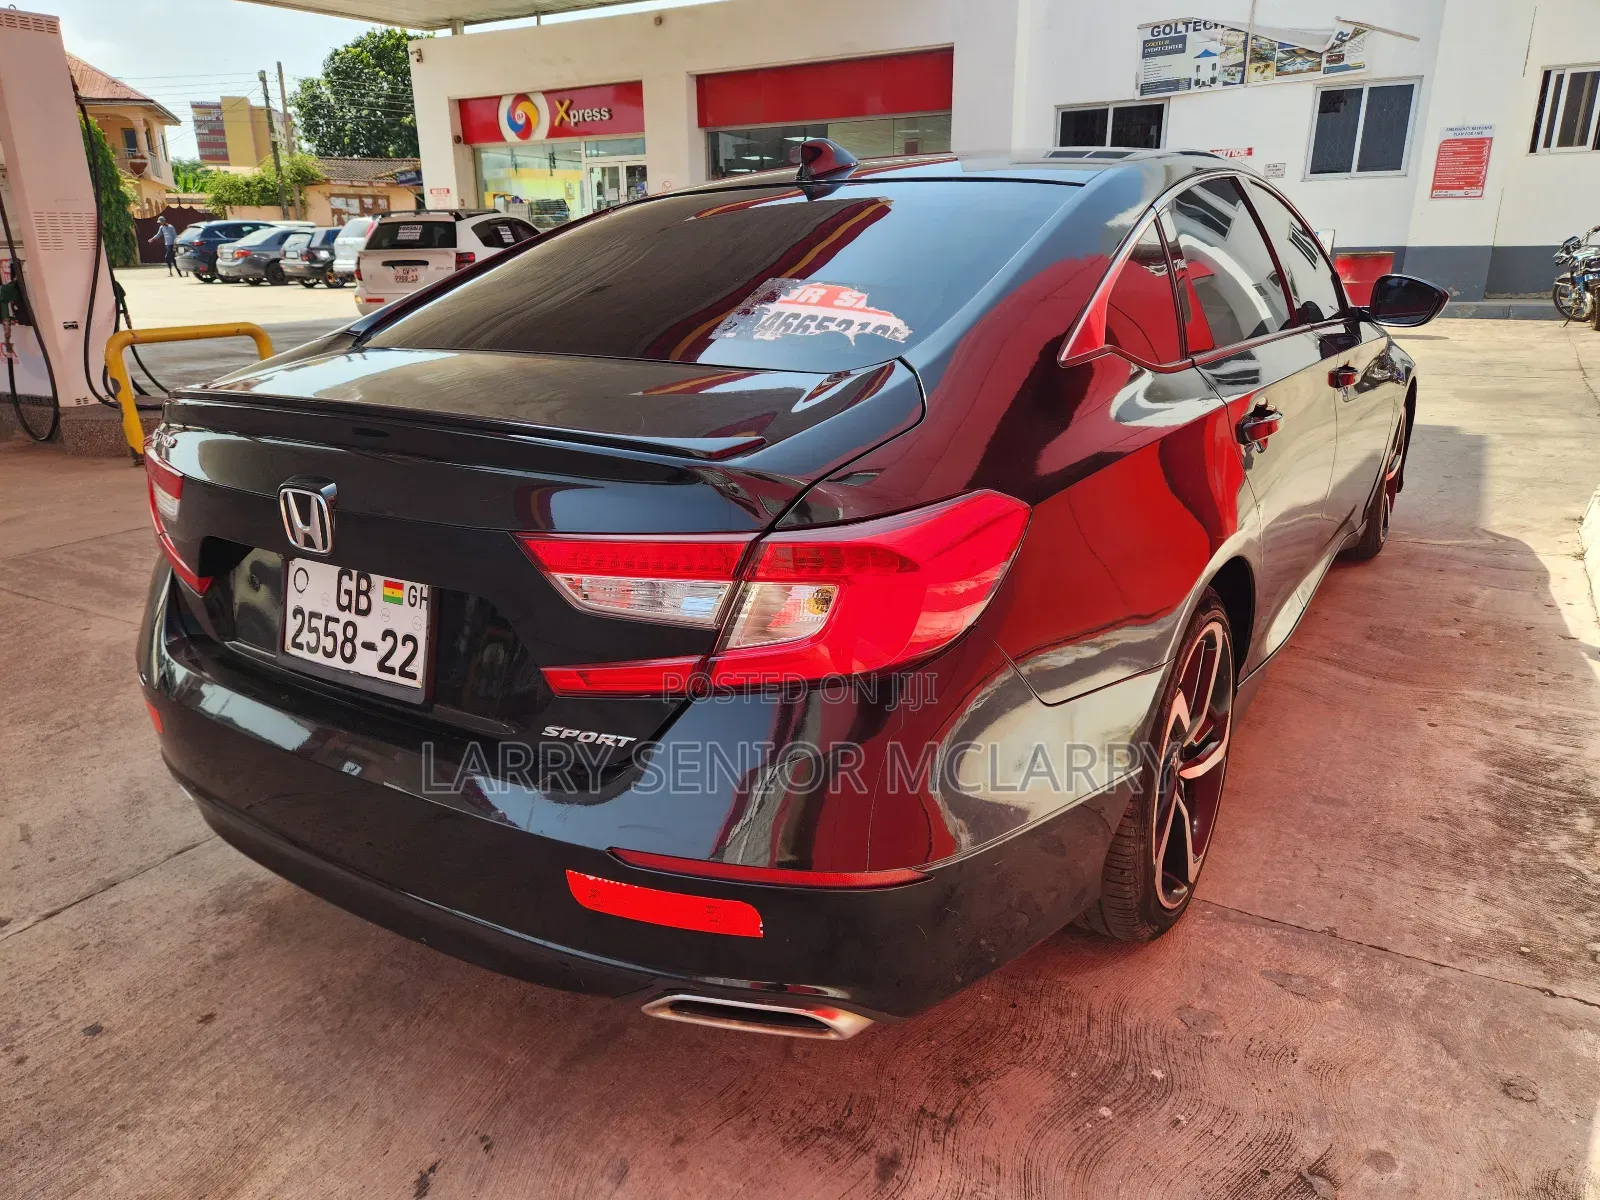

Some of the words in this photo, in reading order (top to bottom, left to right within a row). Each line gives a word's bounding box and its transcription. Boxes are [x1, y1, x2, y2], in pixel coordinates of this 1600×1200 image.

[554, 98, 611, 127] Xpress
[336, 568, 372, 616] GB
[291, 605, 419, 680] 2558-22
[541, 725, 637, 748] SPORT
